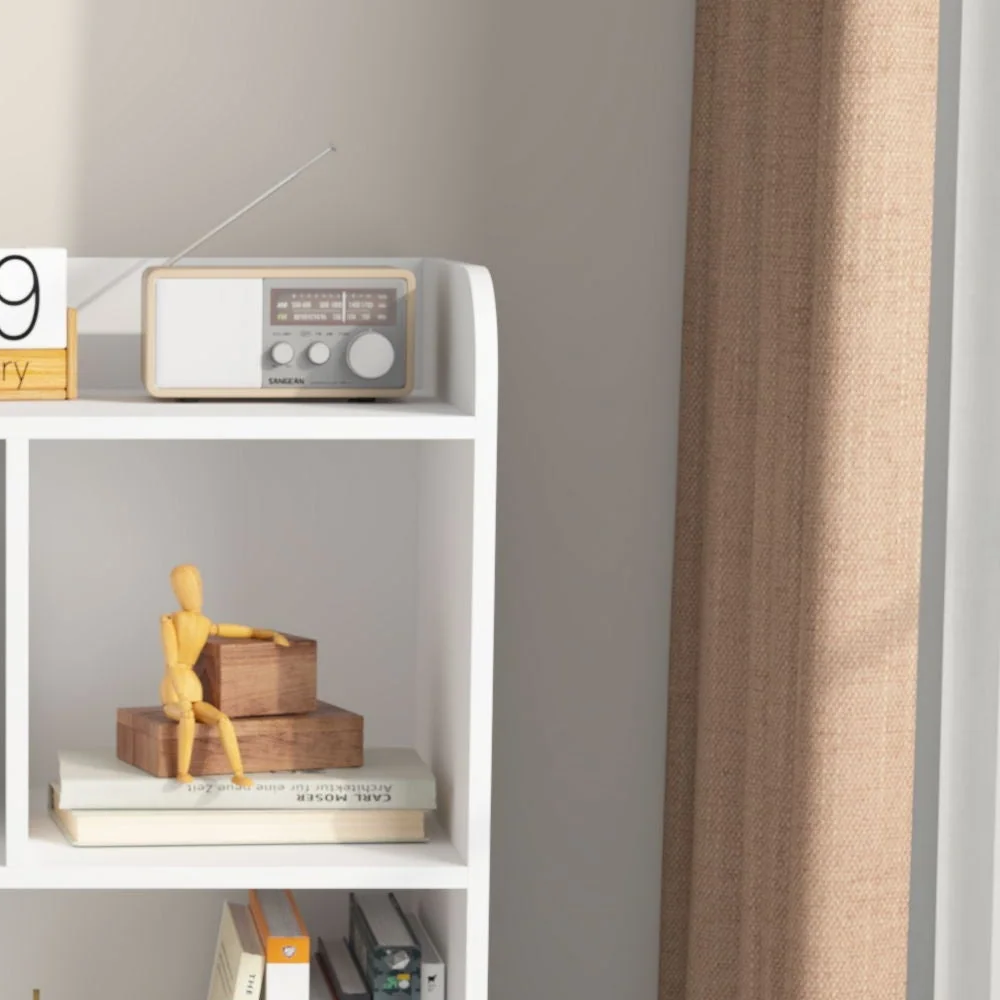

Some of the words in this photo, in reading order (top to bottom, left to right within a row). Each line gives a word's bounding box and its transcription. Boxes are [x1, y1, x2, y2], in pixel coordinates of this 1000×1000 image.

[187, 784, 213, 793] Zeit
[316, 784, 392, 793] Architektur
[296, 794, 347, 802] MOSER
[353, 794, 391, 802] CARL
[246, 973, 256, 996] THE
